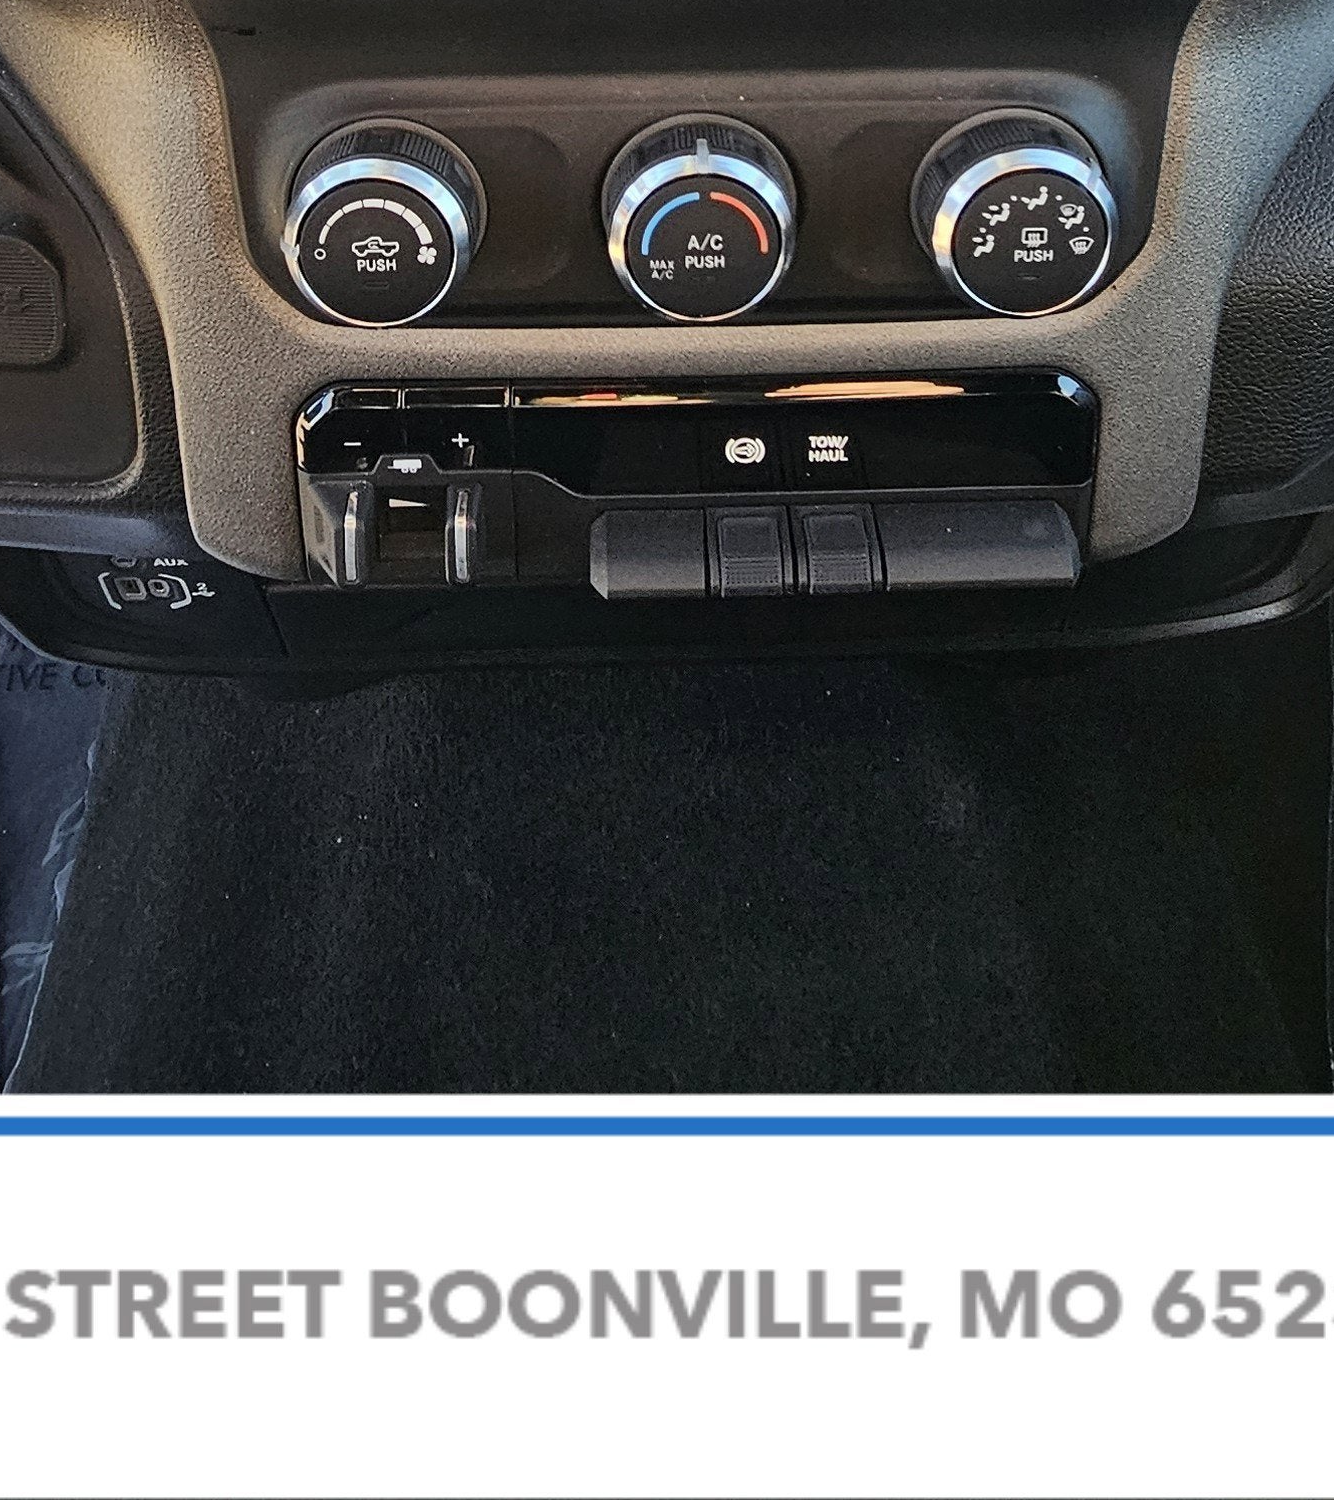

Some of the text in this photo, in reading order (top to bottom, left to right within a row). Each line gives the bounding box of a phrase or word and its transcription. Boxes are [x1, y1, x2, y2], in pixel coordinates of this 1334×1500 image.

[687, 233, 725, 252] A/C
[684, 255, 727, 270] PUSH
[1014, 250, 1055, 263] PUSH
[356, 259, 398, 272] PUSH
[649, 259, 675, 271] MAX
[651, 270, 675, 281] A/C
[807, 435, 850, 451] TOW/
[807, 449, 850, 463] HAUL
[153, 557, 189, 567] AUX
